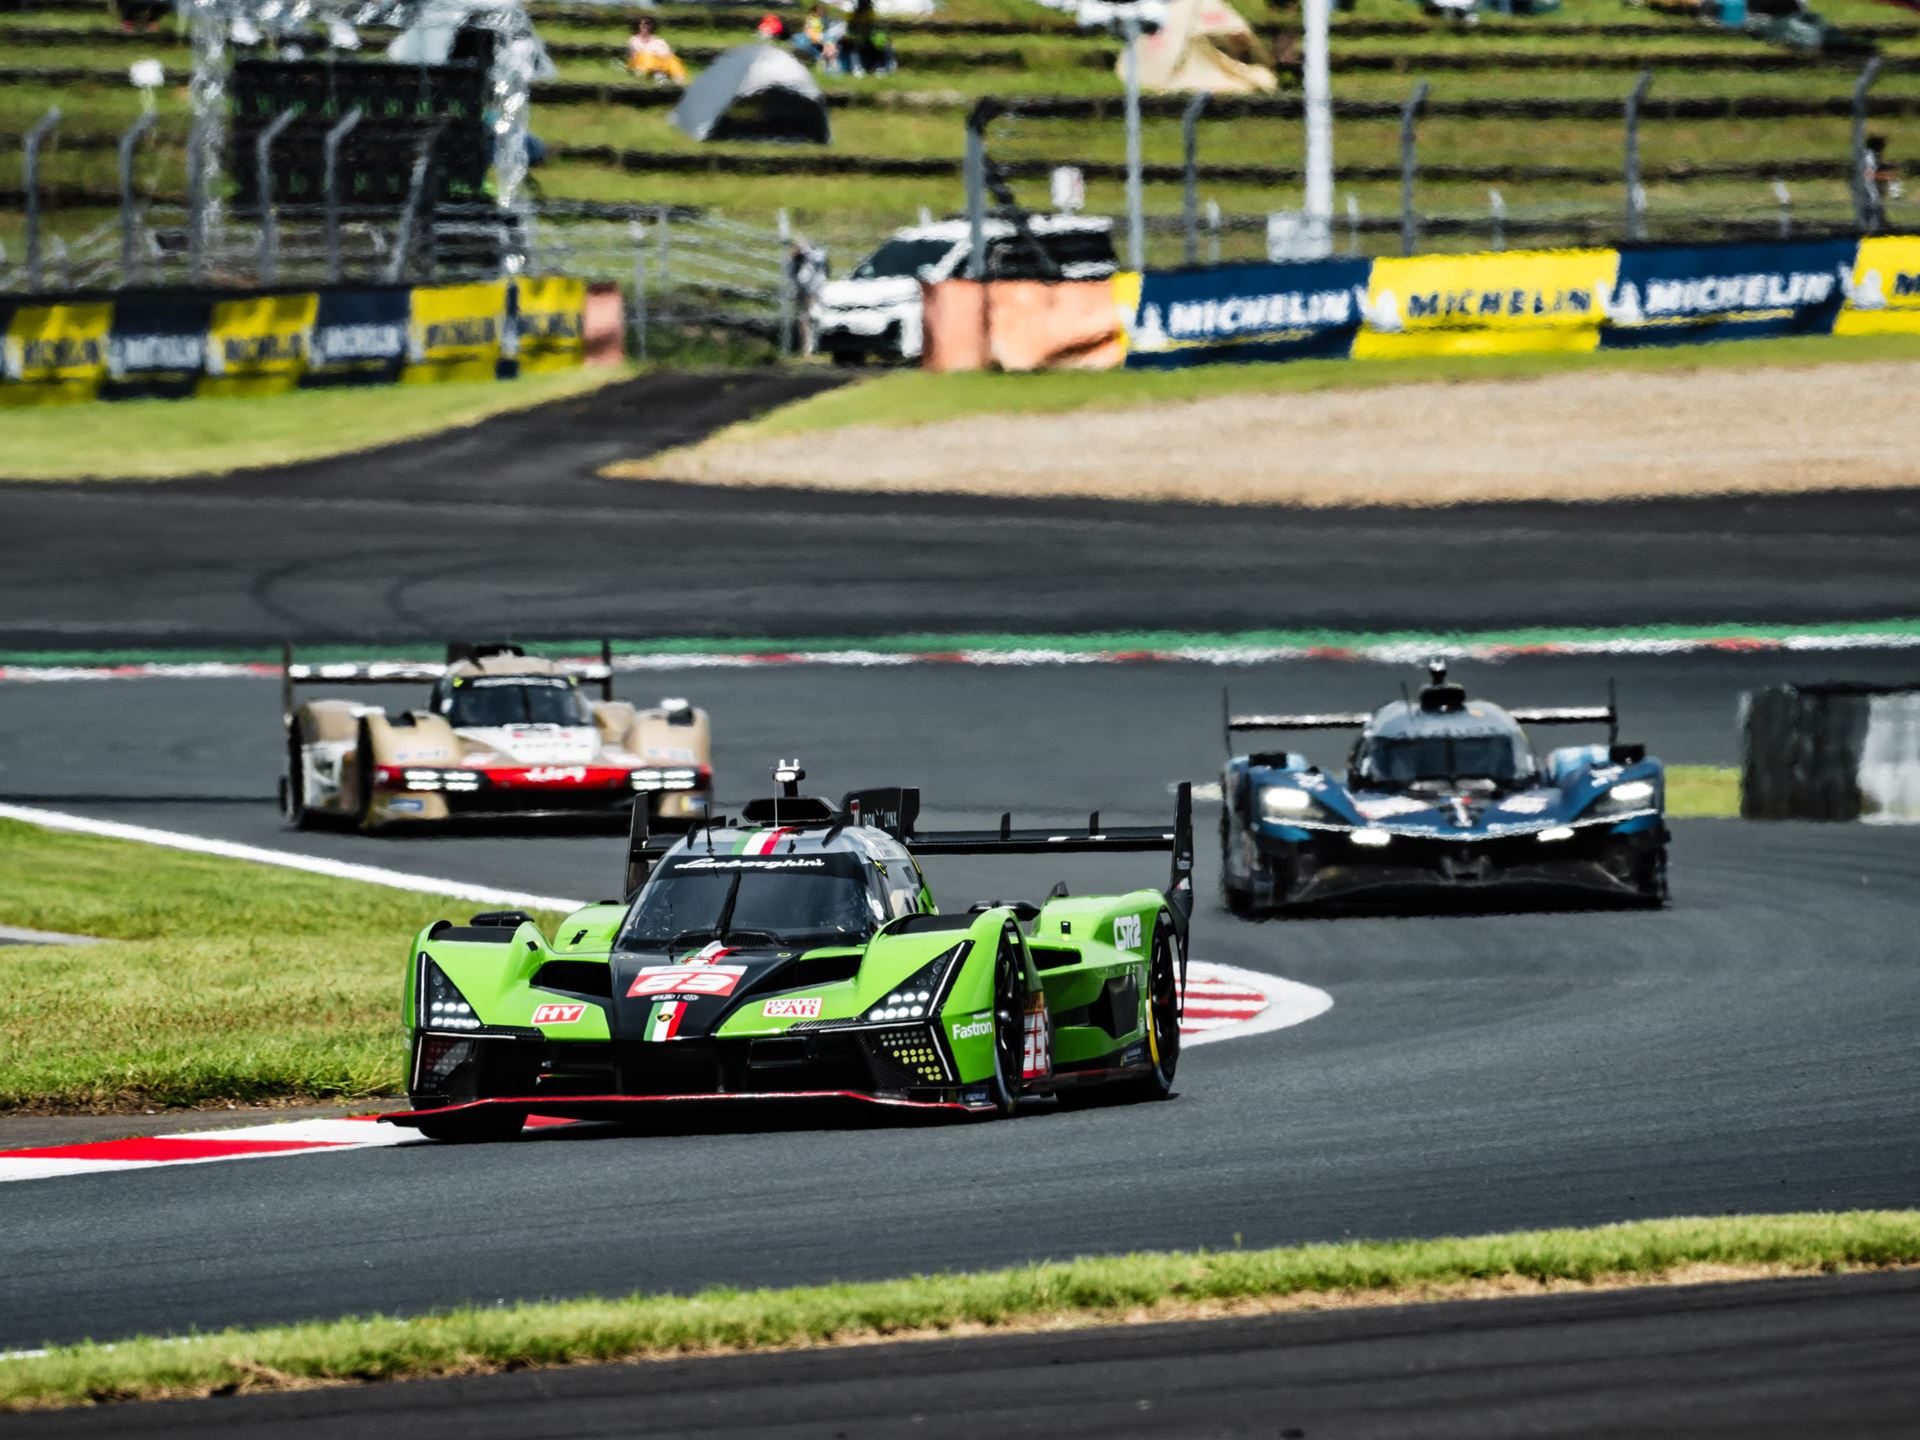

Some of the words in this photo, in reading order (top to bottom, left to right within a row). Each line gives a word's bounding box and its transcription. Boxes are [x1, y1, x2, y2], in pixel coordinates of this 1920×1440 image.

[1408, 288, 1592, 316] MICHELIN
[1646, 271, 1836, 315] MICHELIN
[674, 857, 825, 869] Lamborghini
[633, 973, 734, 993] 63
[537, 1006, 583, 1020] HY
[767, 1005, 816, 1015] CAR
[952, 1021, 993, 1040] Fastron
